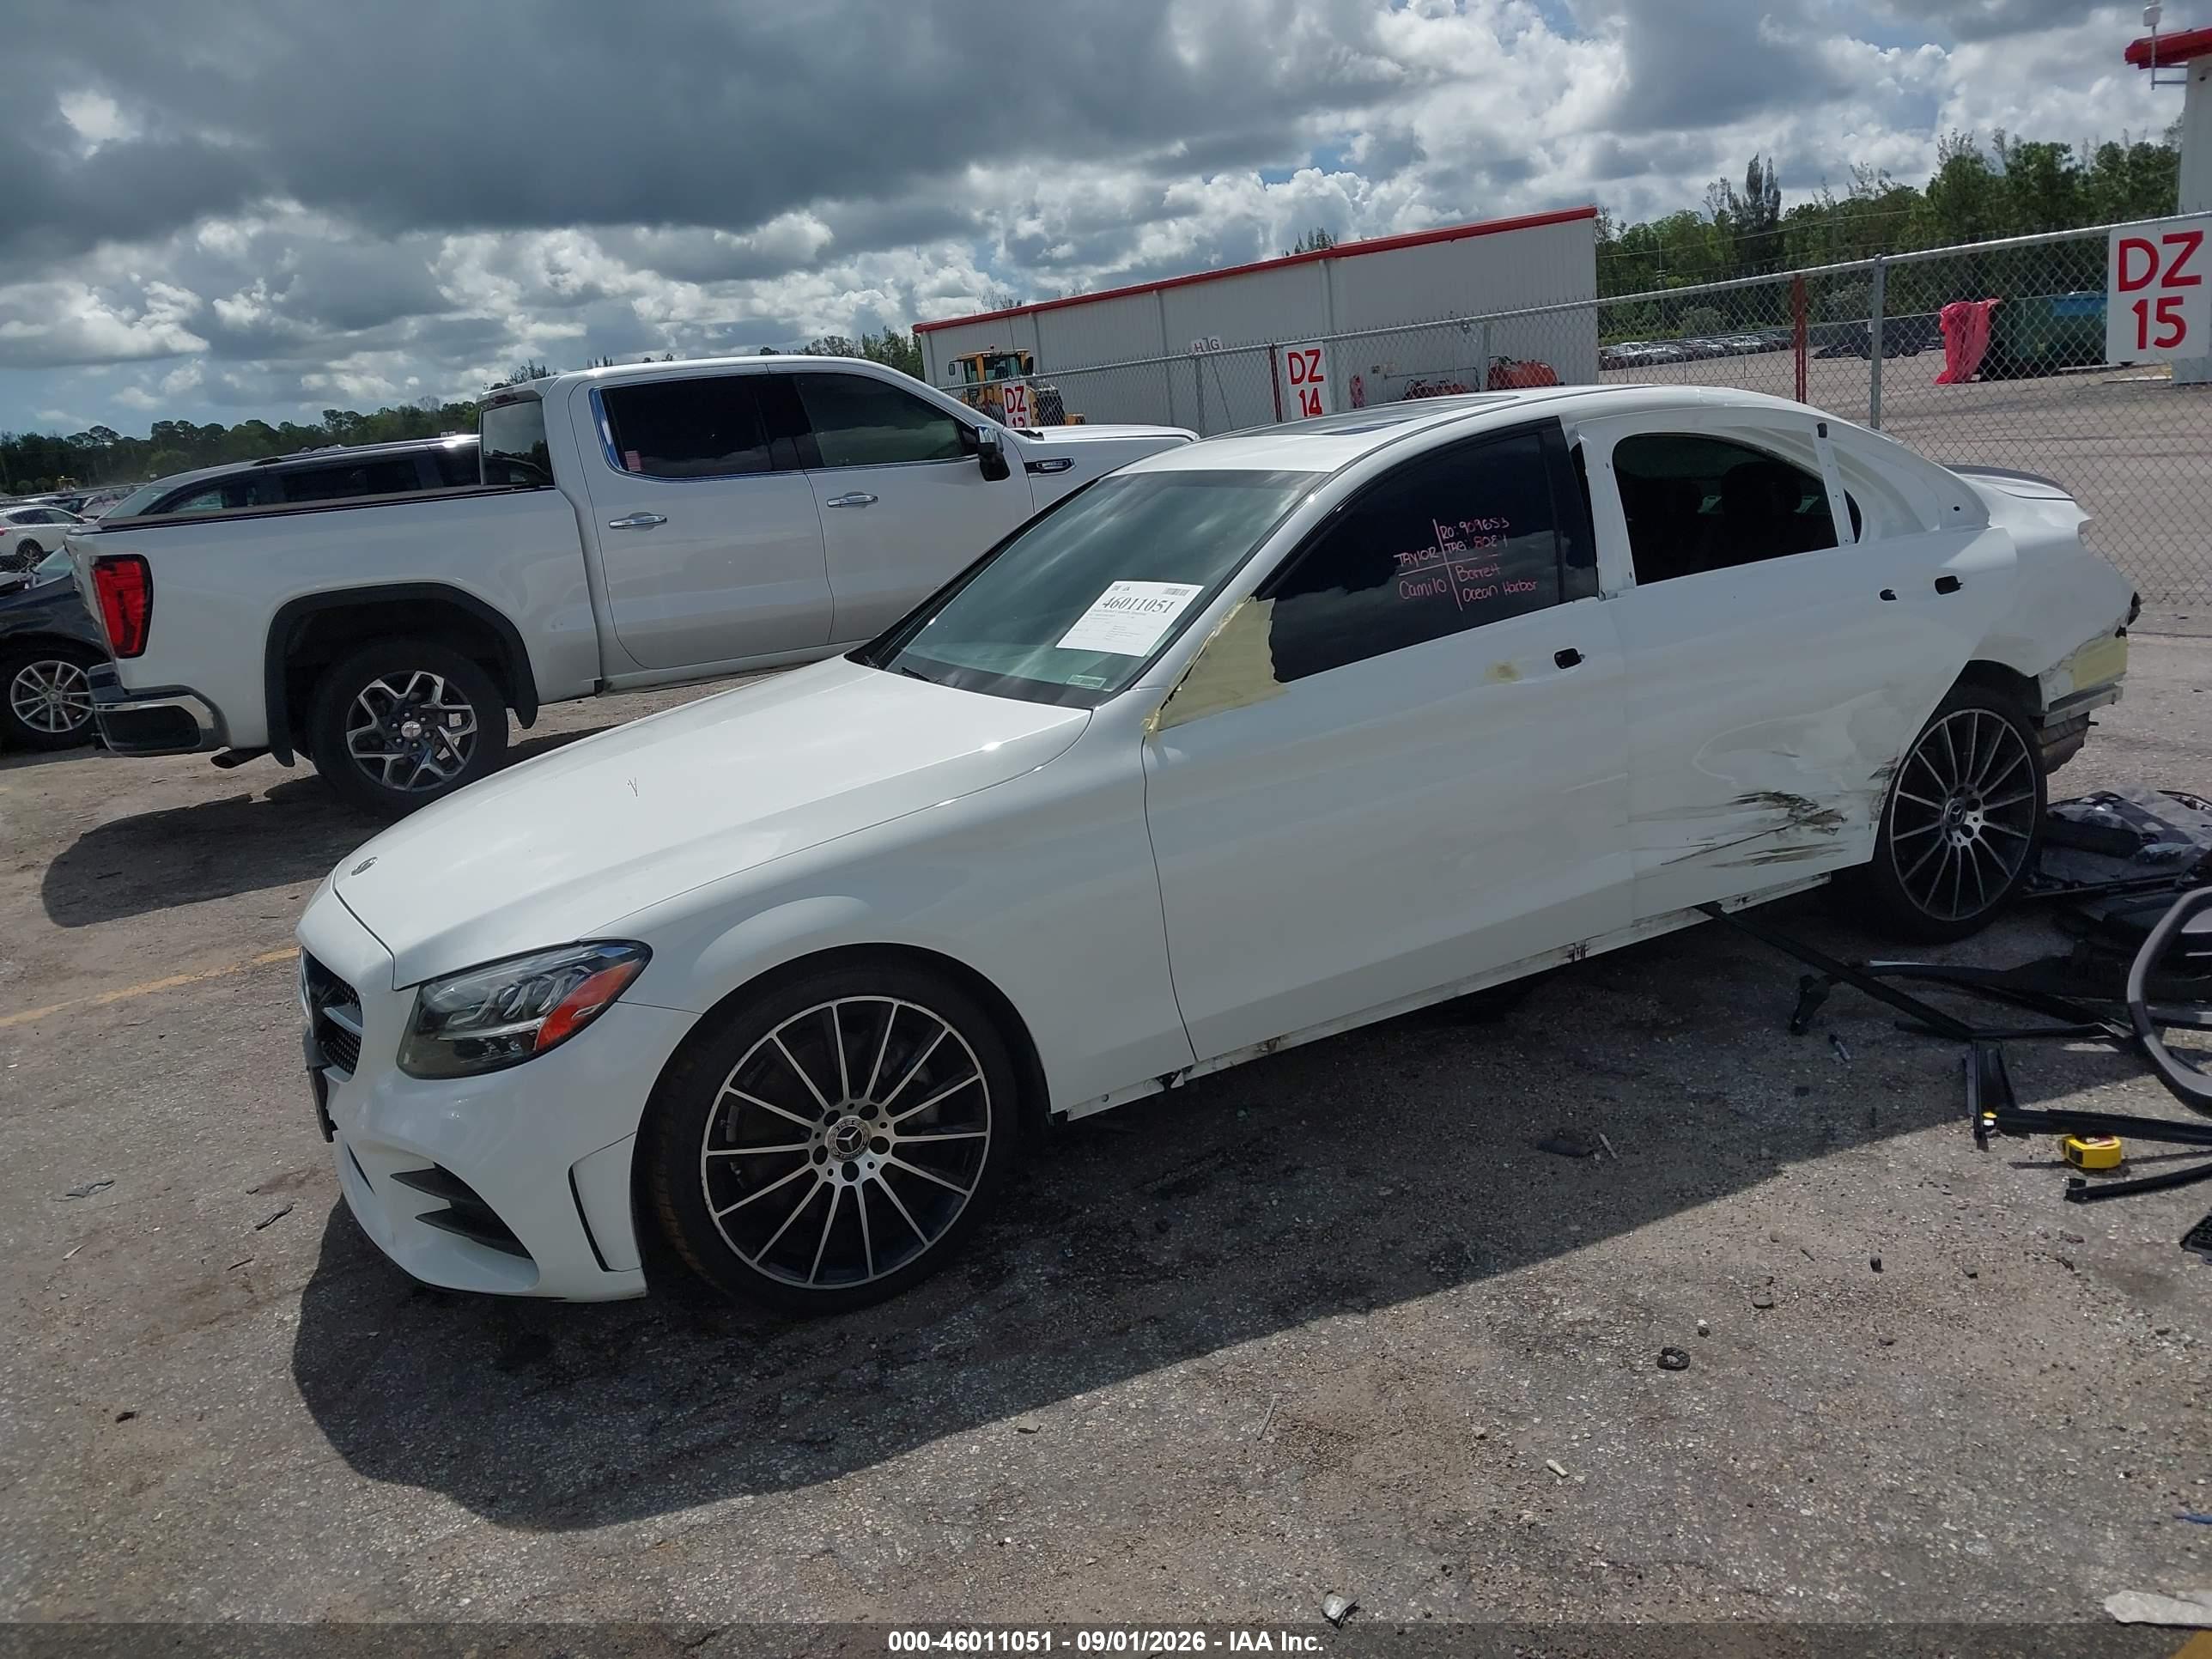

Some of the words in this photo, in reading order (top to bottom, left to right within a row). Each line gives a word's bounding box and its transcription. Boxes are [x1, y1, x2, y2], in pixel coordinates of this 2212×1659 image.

[2118, 230, 2204, 292] DZ
[2131, 295, 2187, 350] 15
[1287, 348, 1324, 386] DZ
[1004, 385, 1027, 414] DZ
[1298, 387, 1323, 417] 14
[1399, 576, 1447, 599] Camilo
[1102, 596, 1176, 613] 46011051
